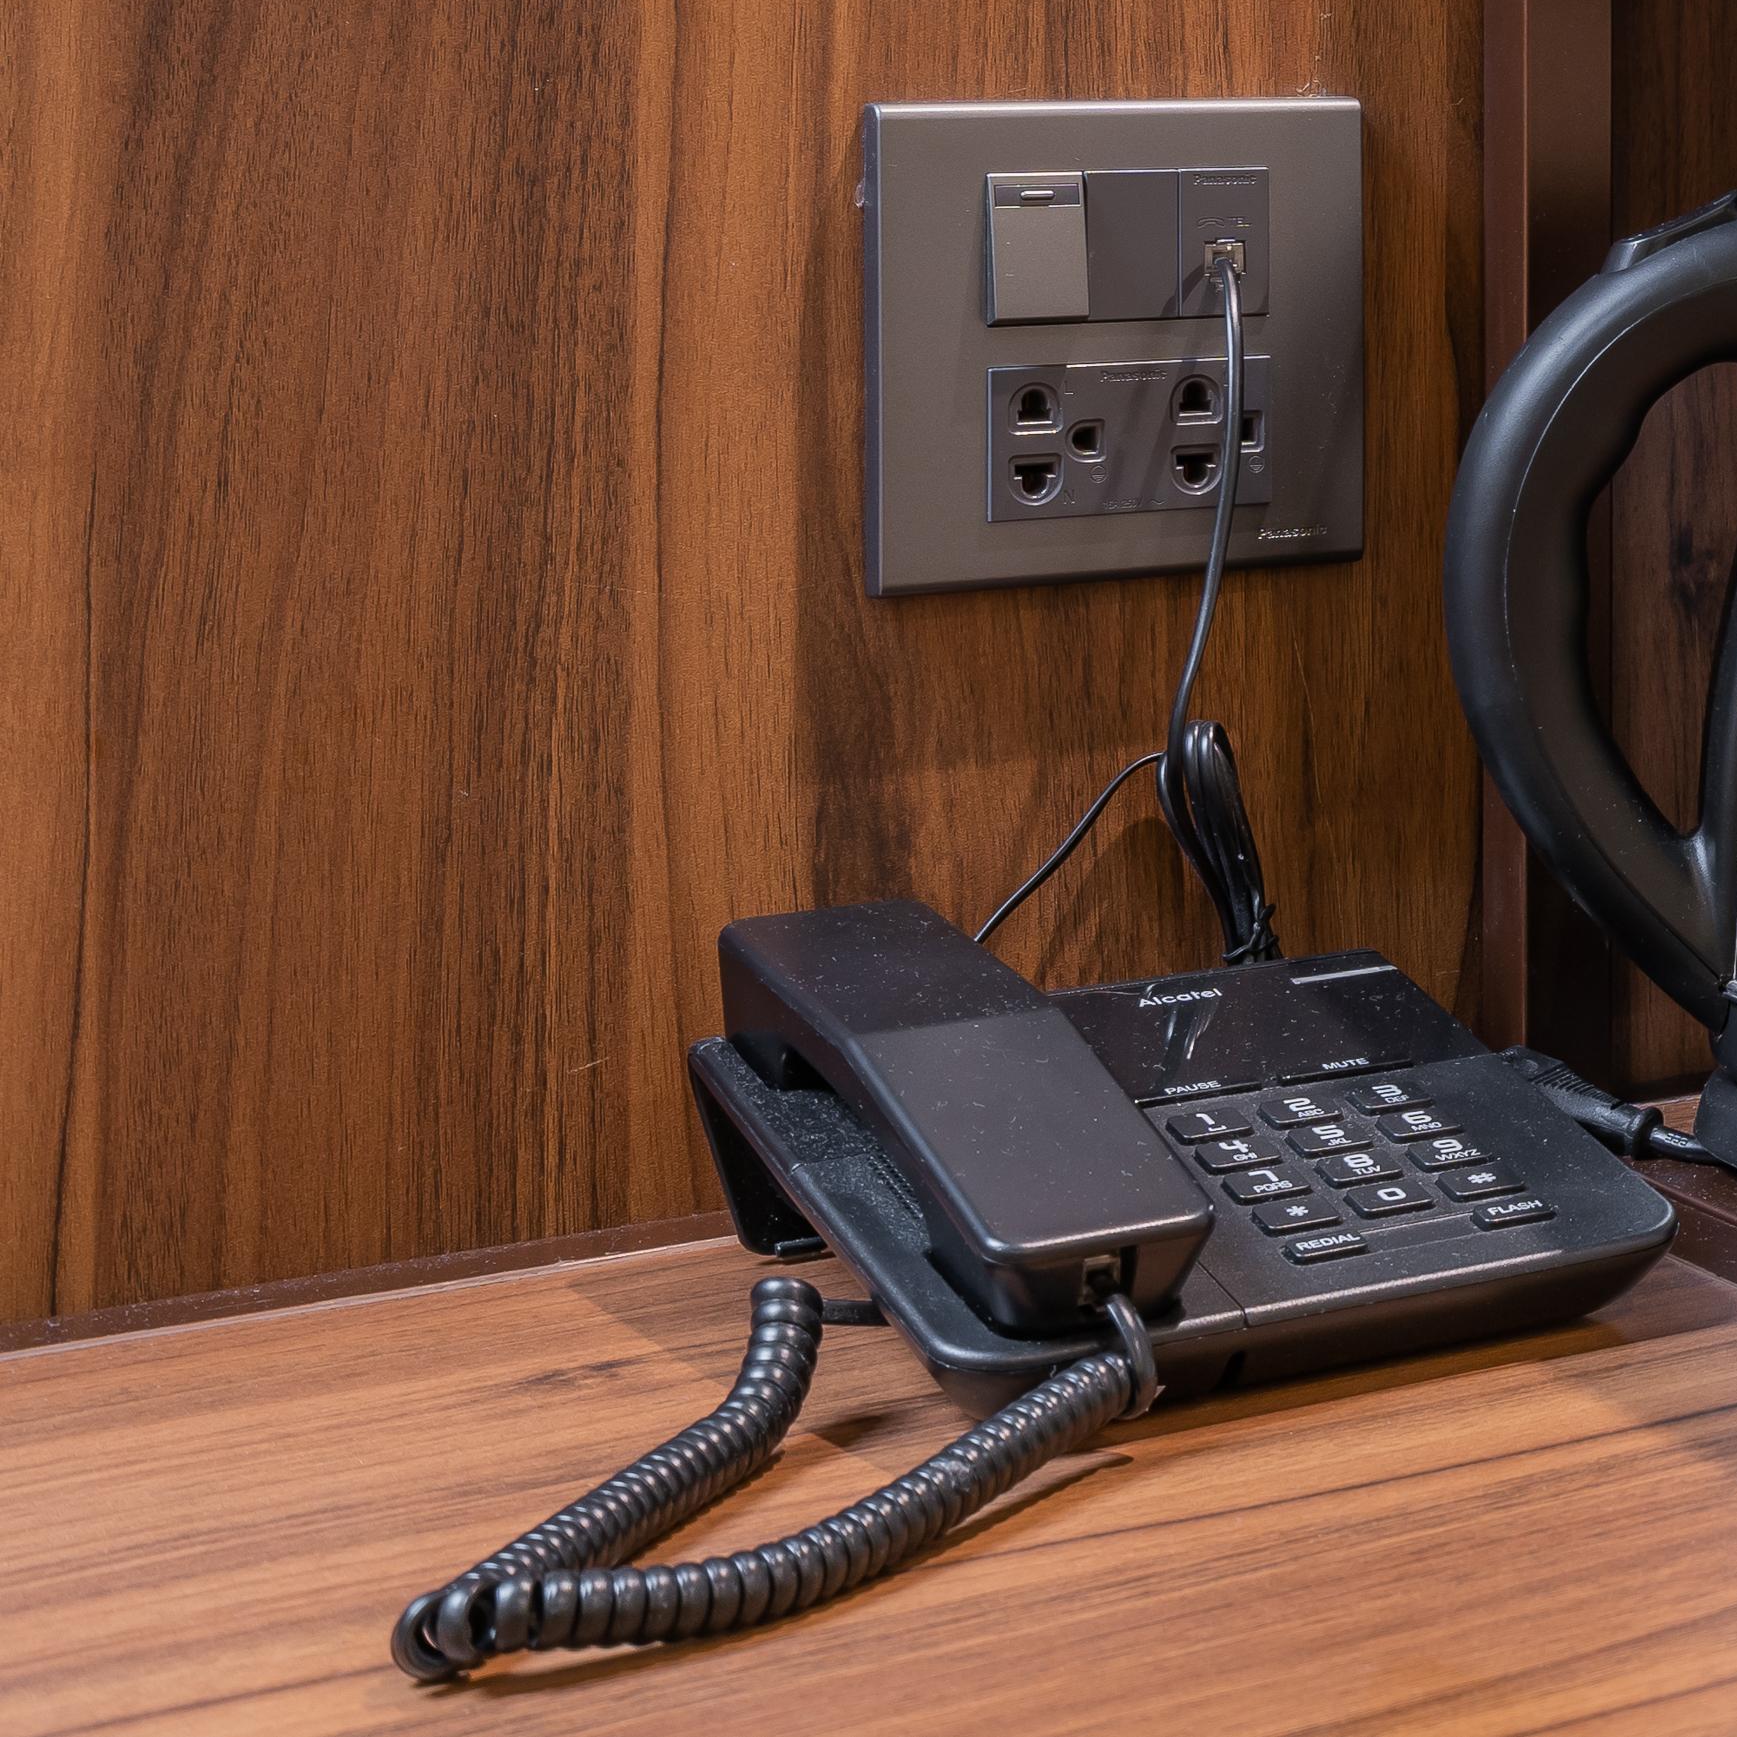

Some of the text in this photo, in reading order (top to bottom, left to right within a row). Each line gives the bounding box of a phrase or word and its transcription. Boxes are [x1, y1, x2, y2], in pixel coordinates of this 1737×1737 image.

[1138, 988, 1223, 1008] Alcatel
[1322, 1057, 1370, 1070] MUTE
[1164, 1080, 1222, 1096] PAUSE
[1372, 1084, 1403, 1098] 3
[1283, 1097, 1316, 1112] 2
[1196, 1113, 1216, 1125] 1
[1401, 1110, 1432, 1125] 6
[1312, 1124, 1352, 1147] 5 JKL
[1218, 1140, 1250, 1153] 4
[1433, 1138, 1481, 1161] 9 WXYZ
[1343, 1153, 1381, 1175] 8 TUV
[1248, 1170, 1279, 1182] 7
[1467, 1172, 1497, 1184] #
[1377, 1187, 1407, 1201] 0
[1487, 1200, 1543, 1216] FLASH
[1295, 1232, 1361, 1251] REDIAL
